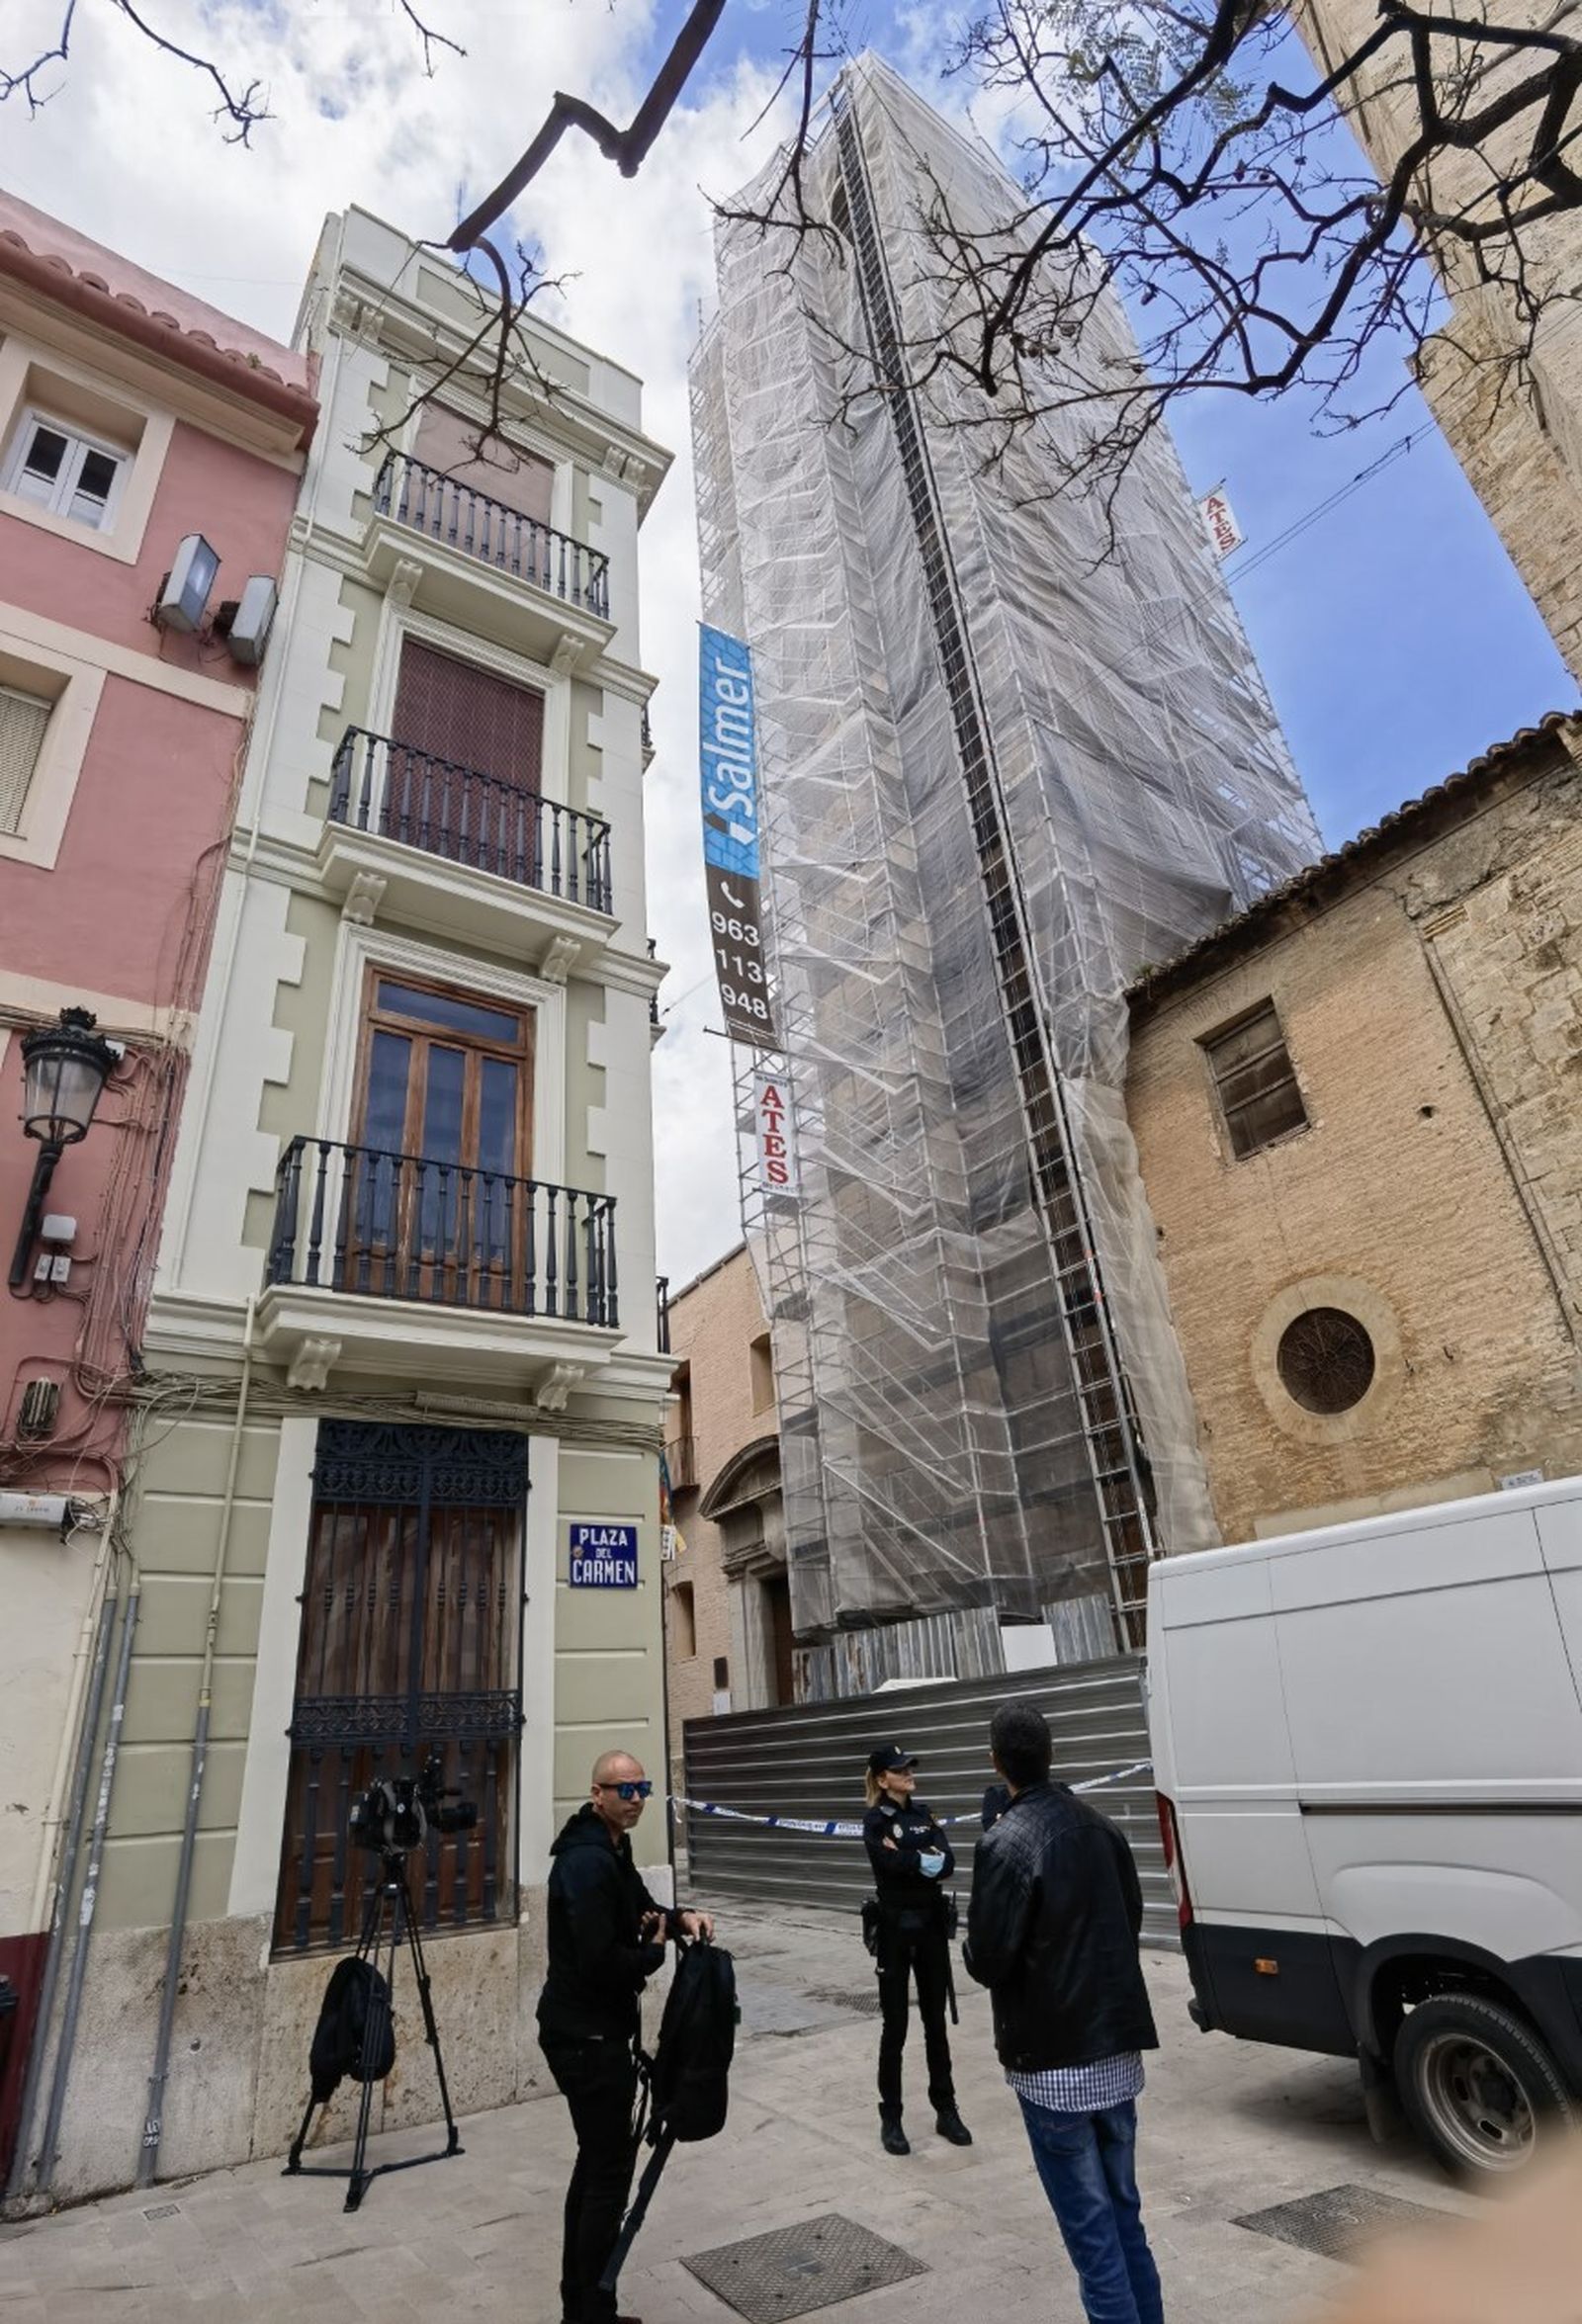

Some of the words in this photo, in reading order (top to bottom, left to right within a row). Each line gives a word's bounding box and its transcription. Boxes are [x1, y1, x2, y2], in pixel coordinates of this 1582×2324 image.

[1206, 496, 1236, 551] ATES
[703, 656, 753, 818] Salmer
[712, 910, 760, 947] 963
[716, 948, 763, 984] 113
[721, 984, 768, 1020] 948
[760, 1084, 789, 1184] ATES
[579, 1527, 628, 1547] PLAZA
[595, 1547, 613, 1559] DEL
[573, 1559, 636, 1585] CARMEN
